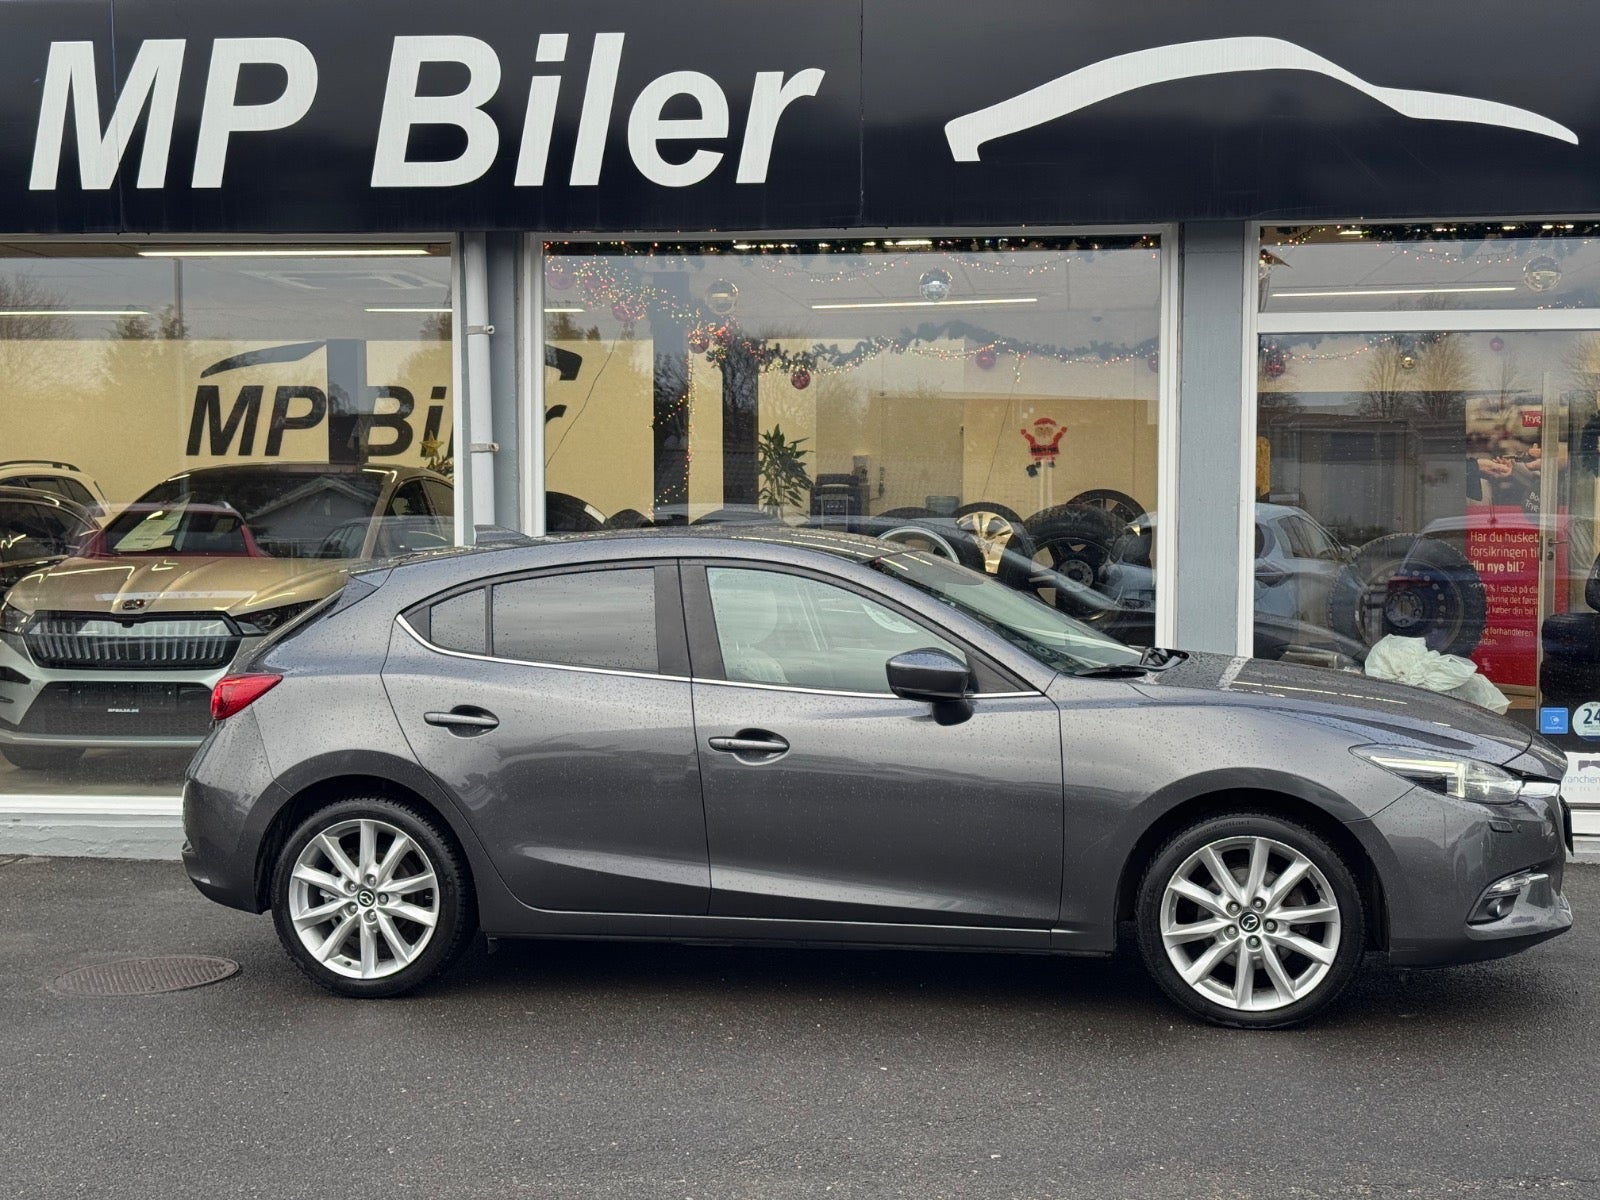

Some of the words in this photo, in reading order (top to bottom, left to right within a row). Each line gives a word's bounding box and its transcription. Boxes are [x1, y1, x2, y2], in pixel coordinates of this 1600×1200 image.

[29, 37, 319, 190] MP
[370, 32, 826, 188] Biler
[186, 385, 327, 456] MP
[1471, 531, 1487, 542] Har
[1490, 531, 1502, 542] du
[1505, 531, 1539, 543] husket
[1470, 545, 1527, 560] forsikringen
[1487, 562, 1505, 574] nye
[1507, 560, 1525, 572] bil?
[1490, 627, 1534, 637] forhandleren
